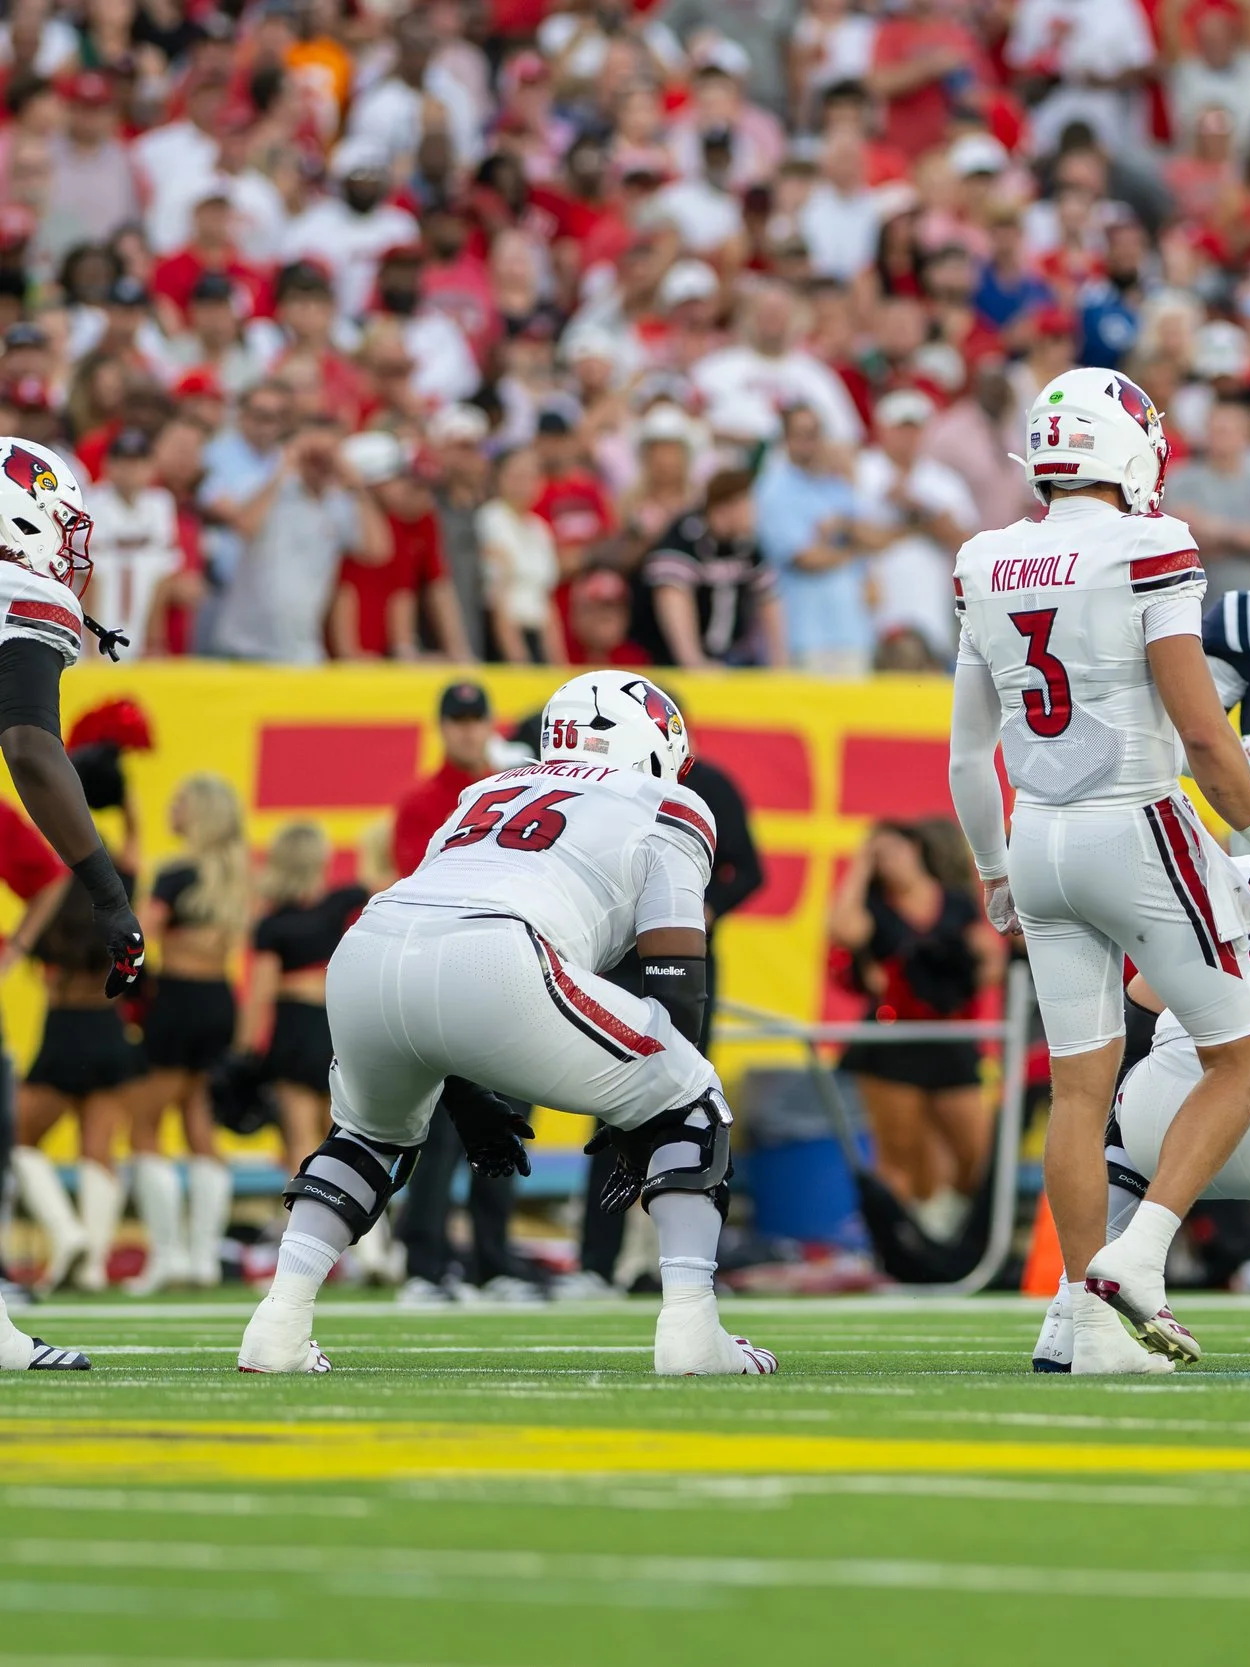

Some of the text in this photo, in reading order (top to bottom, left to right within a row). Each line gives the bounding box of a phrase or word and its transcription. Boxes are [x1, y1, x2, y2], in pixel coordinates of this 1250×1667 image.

[1047, 416, 1062, 447] 3
[991, 552, 1079, 592] KIENHOLZ
[1007, 607, 1072, 738] 3
[552, 719, 578, 749] 56
[440, 785, 585, 853] 56
[304, 1184, 346, 1206] DONJOY
